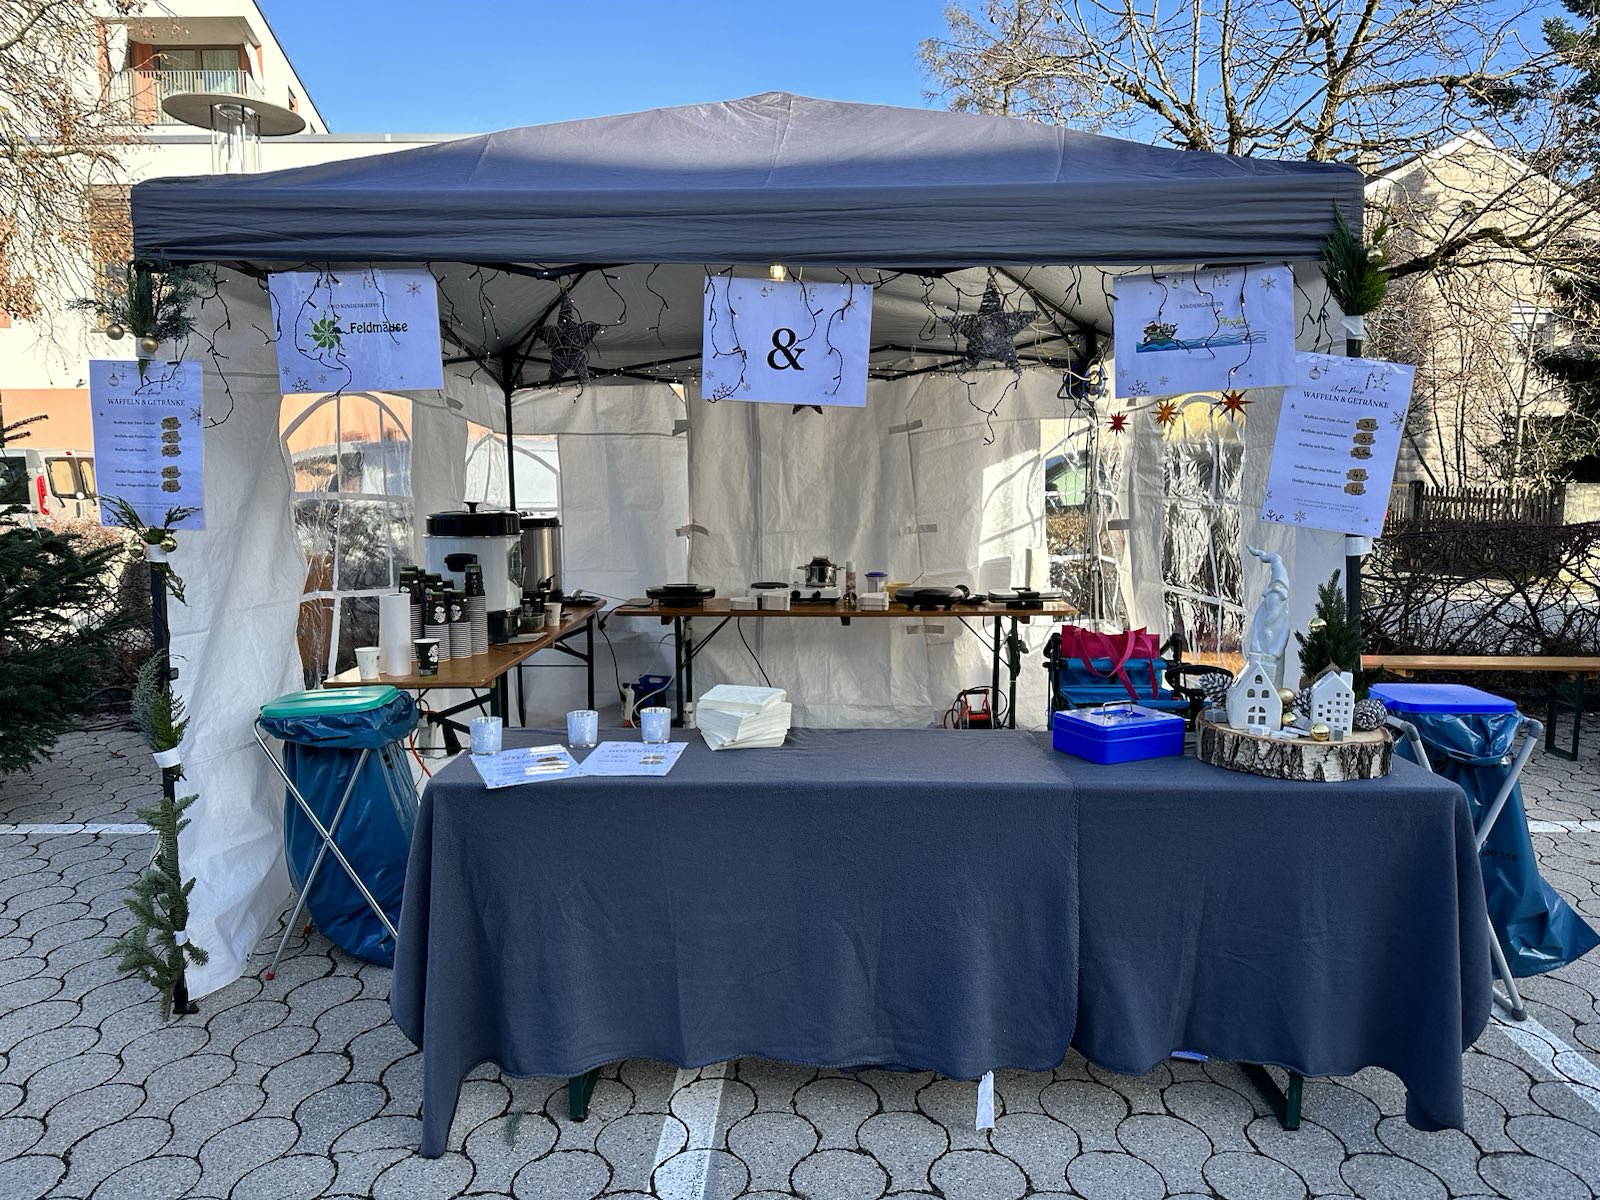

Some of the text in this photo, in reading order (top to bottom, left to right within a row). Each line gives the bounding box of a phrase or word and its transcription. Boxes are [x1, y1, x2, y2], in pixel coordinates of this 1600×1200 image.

[767, 328, 805, 370] &
[148, 398, 186, 406] GETRÄNKE
[1304, 391, 1339, 402] WAFFELN
[1347, 397, 1390, 408] GETRÄNKE
